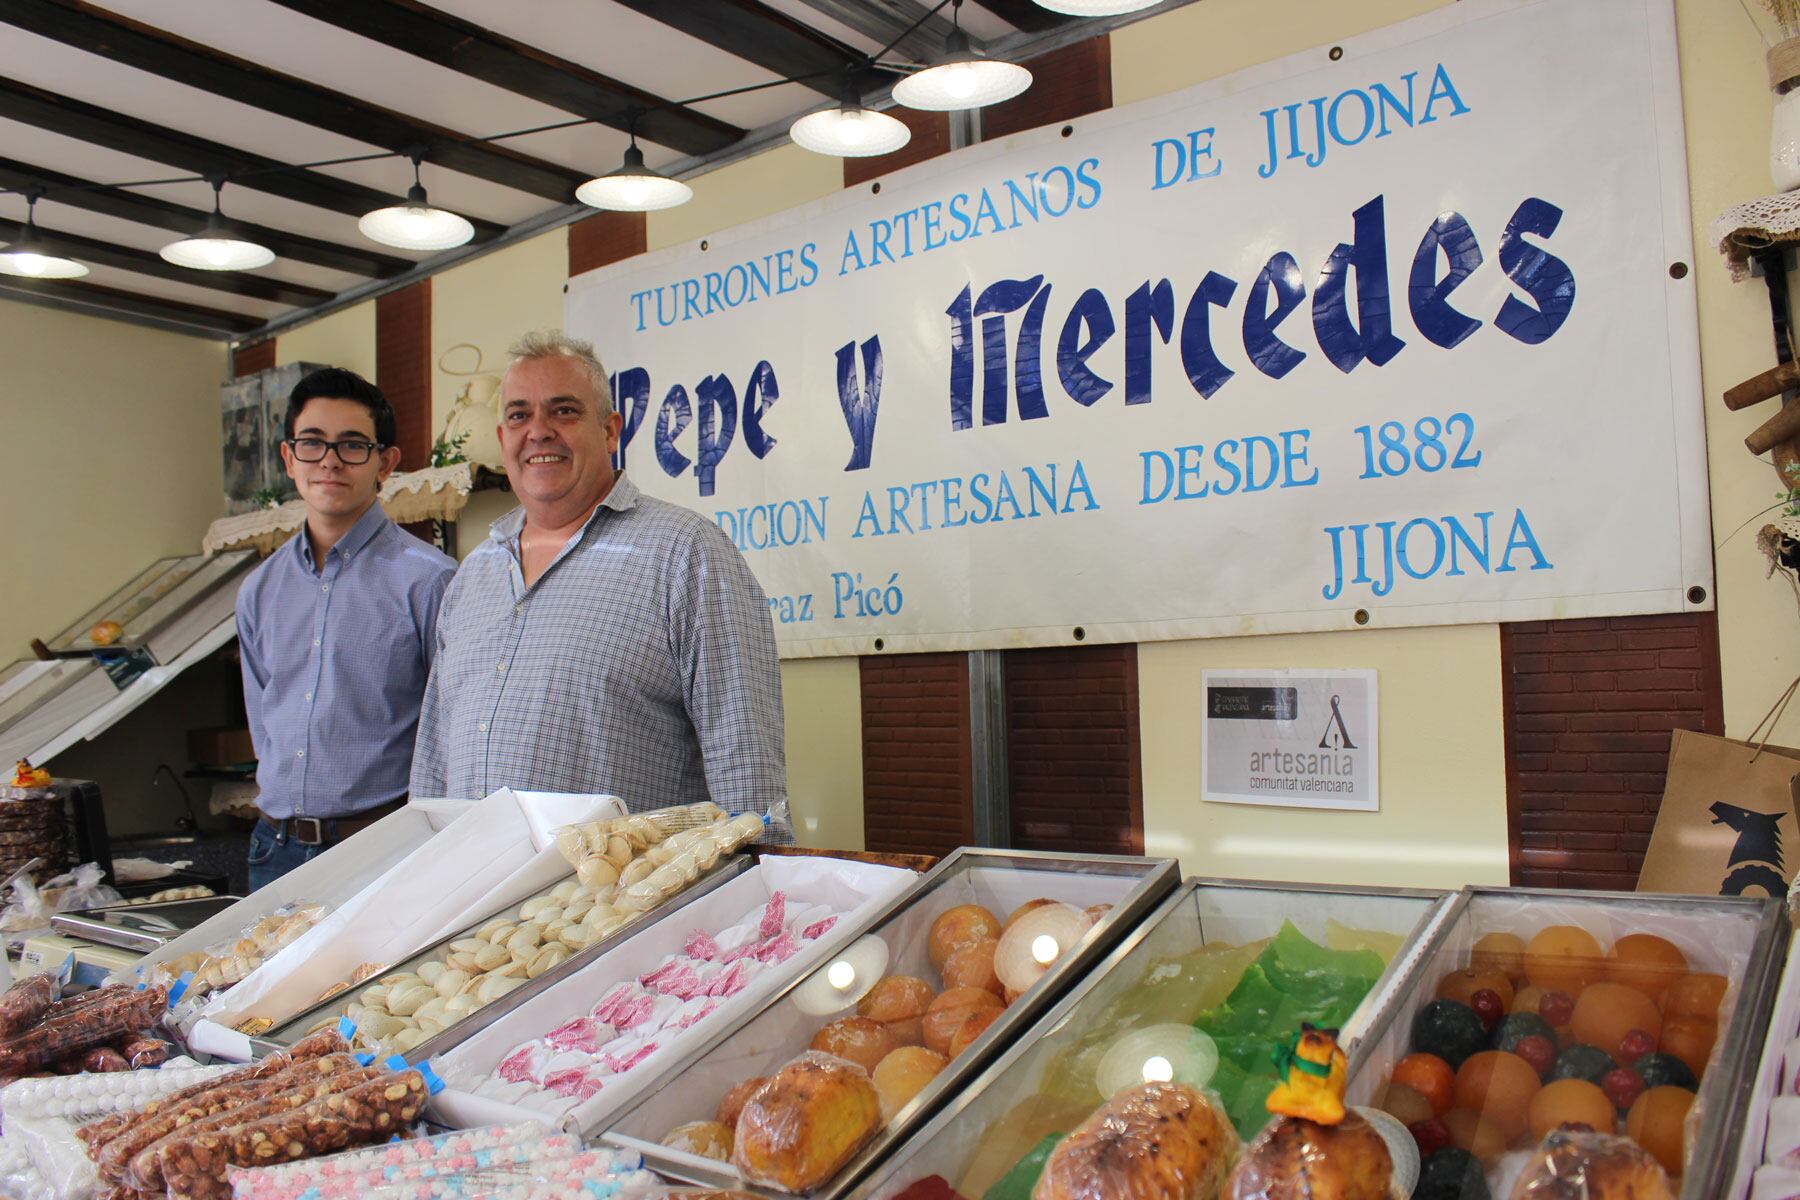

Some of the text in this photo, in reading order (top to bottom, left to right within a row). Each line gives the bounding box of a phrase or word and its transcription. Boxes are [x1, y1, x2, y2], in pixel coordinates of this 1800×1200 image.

[631, 64, 1471, 331] TURRONES ARTESANOS DE JIJONA
[608, 194, 1576, 497] Pepe y Mercedes
[715, 412, 1482, 552] DICION ARTESANA DESDE 1882
[767, 572, 903, 624] az Picó
[1322, 508, 1553, 601] JIJONA
[1250, 776, 1354, 793] comunitat valenciana
